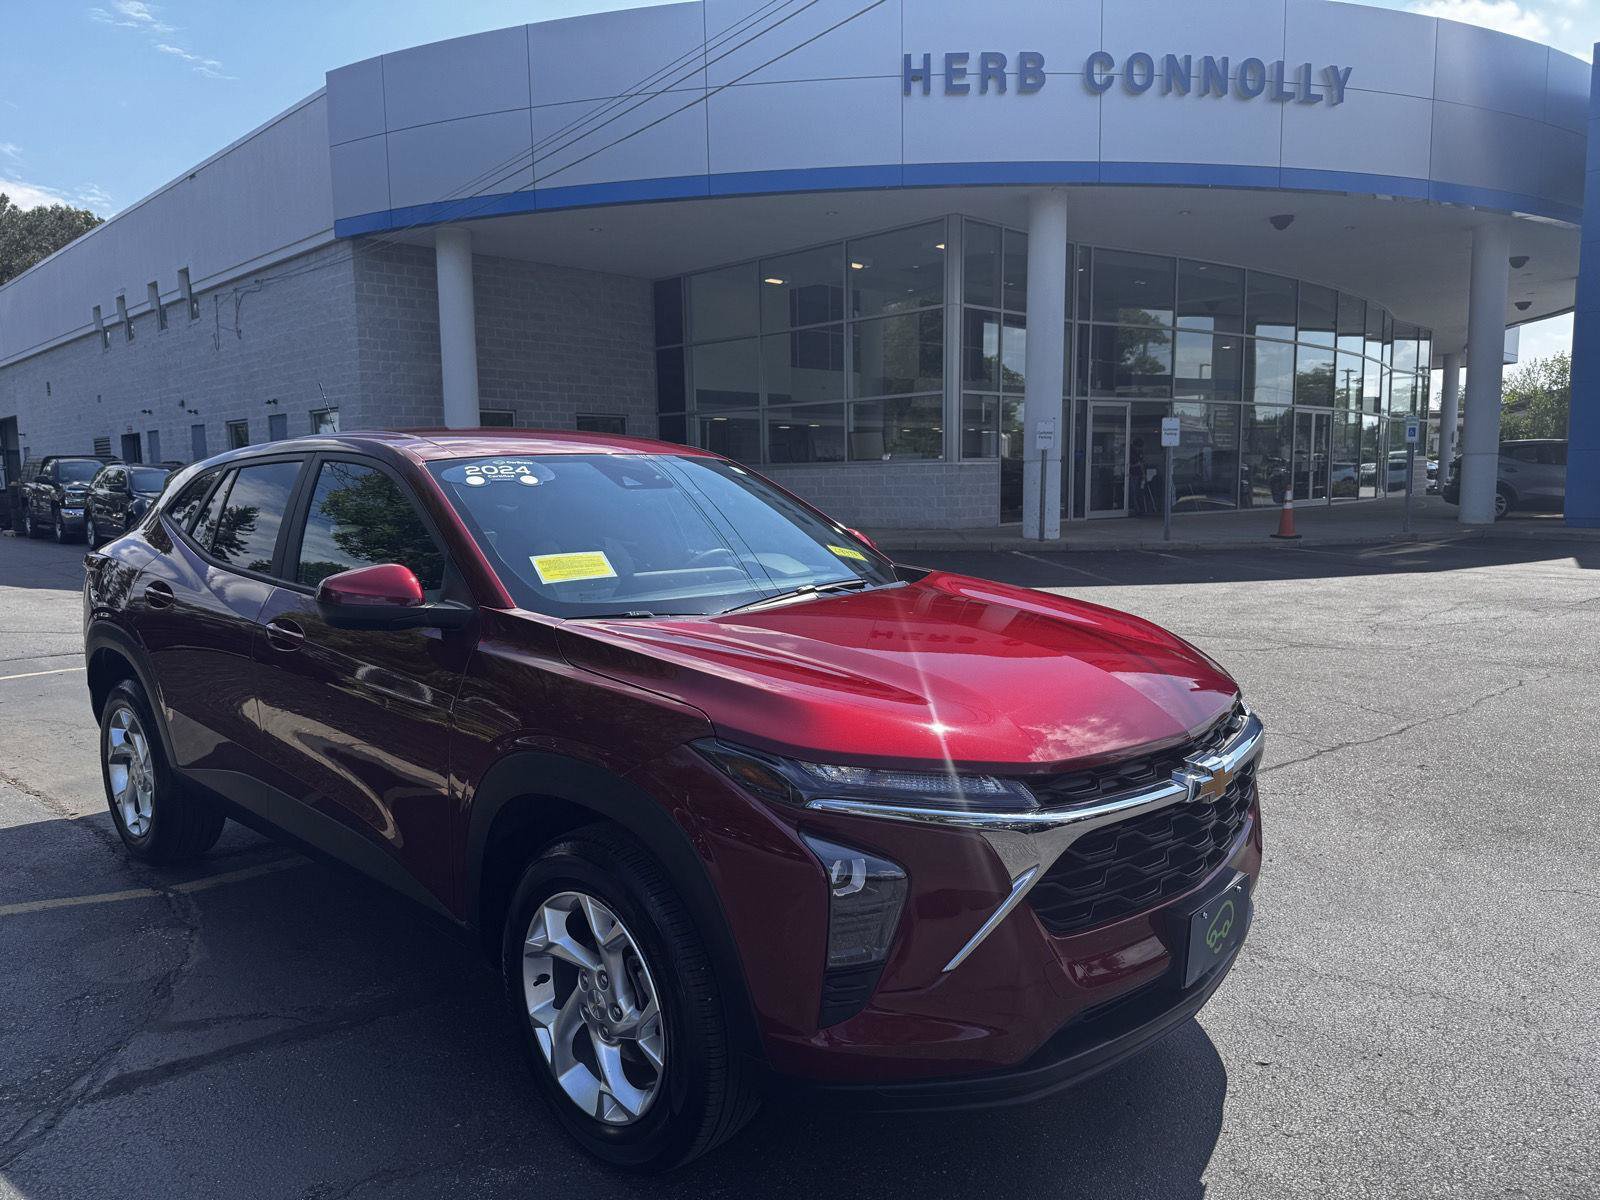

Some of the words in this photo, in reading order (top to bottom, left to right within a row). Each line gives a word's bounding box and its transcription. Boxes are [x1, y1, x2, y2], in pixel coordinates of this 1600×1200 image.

[903, 52, 1046, 95] HERB
[1084, 51, 1353, 105] CONNOLLY
[464, 465, 531, 475] 2024
